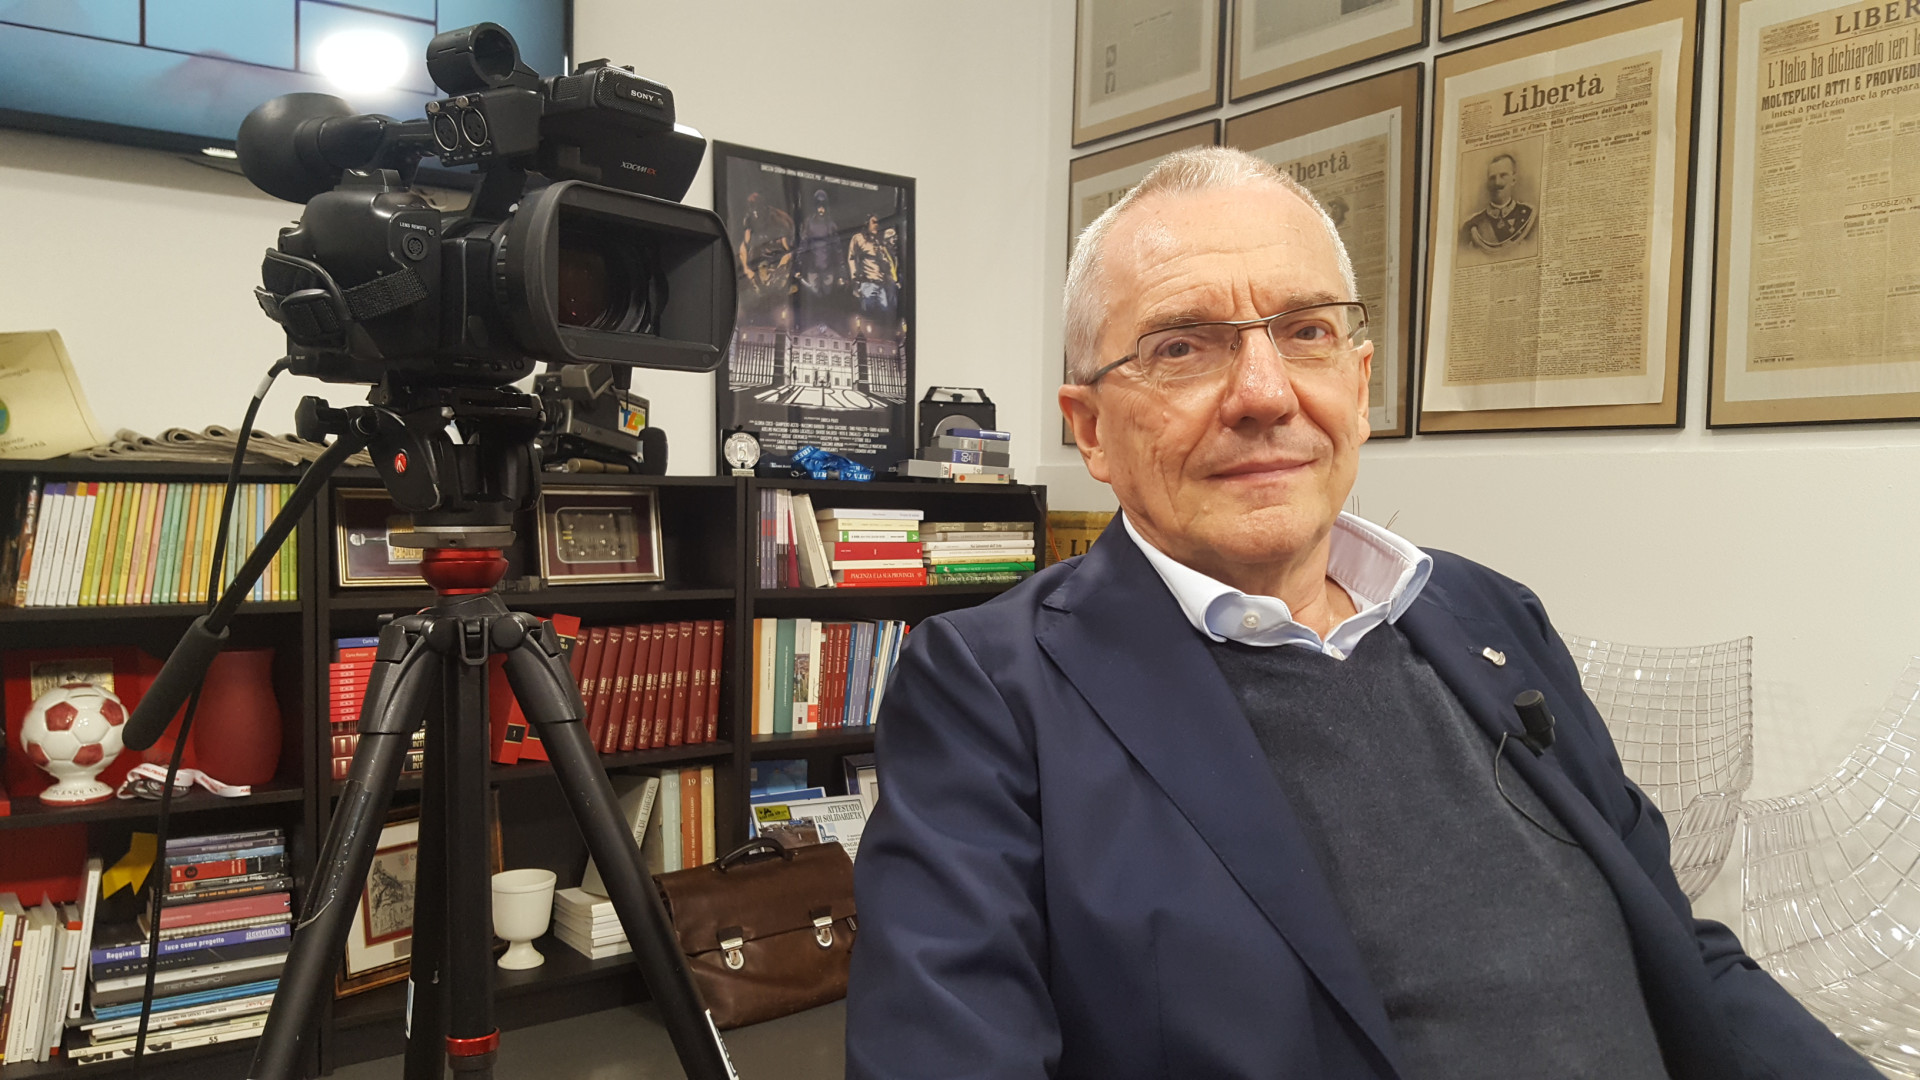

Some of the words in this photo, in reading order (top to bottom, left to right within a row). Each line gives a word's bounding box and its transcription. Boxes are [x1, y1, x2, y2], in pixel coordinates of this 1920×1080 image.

[1768, 56, 1807, 89] L'Italia
[1811, 51, 1824, 79] ha
[1828, 40, 1884, 75] dichiarato
[1888, 30, 1909, 62] ieri
[630, 89, 654, 102] SONY
[1502, 72, 1604, 117] Libertà
[1761, 84, 1821, 111] MOLTEPLICI
[1825, 78, 1850, 97] ATTI
[1855, 75, 1862, 91] E
[1772, 105, 1796, 119] intesi
[1798, 106, 1804, 114] a
[1806, 92, 1866, 117] perfezionare
[1868, 89, 1878, 99] la
[1880, 82, 1920, 99] prepara
[411, 223, 427, 232] REMOTE
[687, 778, 697, 787] 19
[704, 776, 714, 785] 20
[827, 803, 860, 814] ATTESTATO
[814, 815, 823, 824] DI
[106, 949, 136, 960] Reggiani
[199, 936, 225, 949] progetto
[208, 1036, 219, 1045] 55
